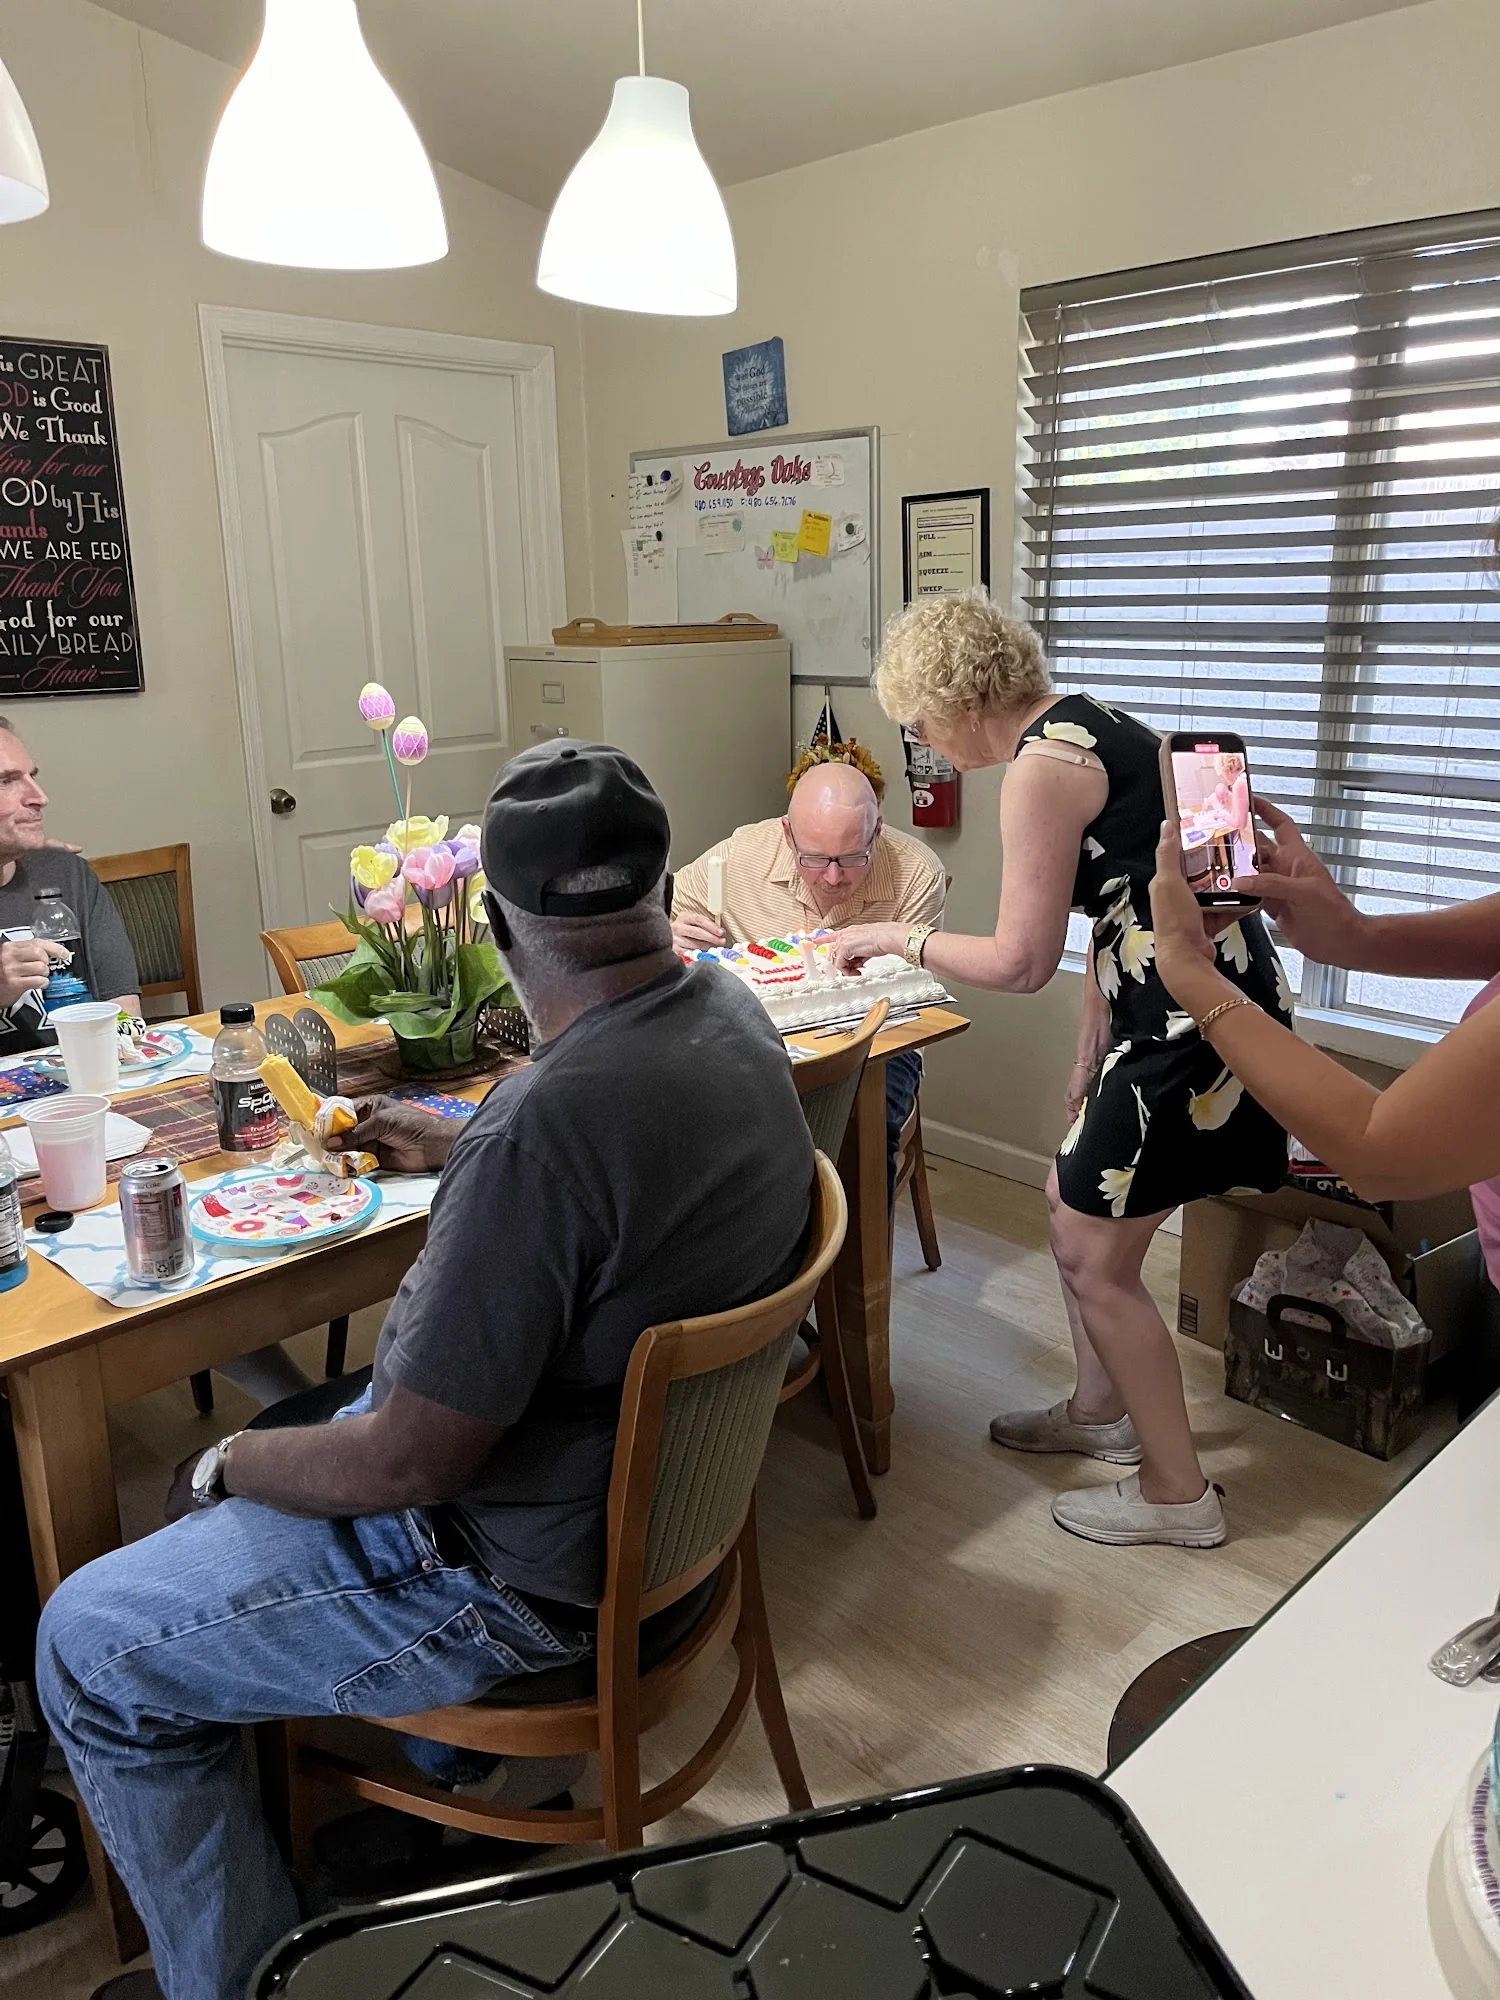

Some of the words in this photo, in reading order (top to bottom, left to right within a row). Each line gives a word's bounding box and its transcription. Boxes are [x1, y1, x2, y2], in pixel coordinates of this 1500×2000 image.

[18, 352, 102, 385] GREAT
[749, 365, 766, 378] God
[32, 389, 47, 407] is
[50, 386, 103, 414] Good
[736, 390, 768, 408] possible
[35, 415, 108, 446] Thank
[0, 446, 32, 473] im
[72, 463, 108, 477] our
[51, 484, 73, 517] by
[66, 491, 120, 534] His
[918, 533, 936, 541] PULL
[45, 541, 82, 560] ARE
[91, 541, 122, 560] FED
[918, 551, 933, 559] AIM
[918, 568, 949, 576] SQUEEZE
[68, 566, 124, 609] You
[47, 600, 77, 638] for
[89, 614, 123, 627] our
[57, 631, 133, 654] BREAD
[21, 656, 99, 690] Amen
[237, 1092, 277, 1111] SPO
